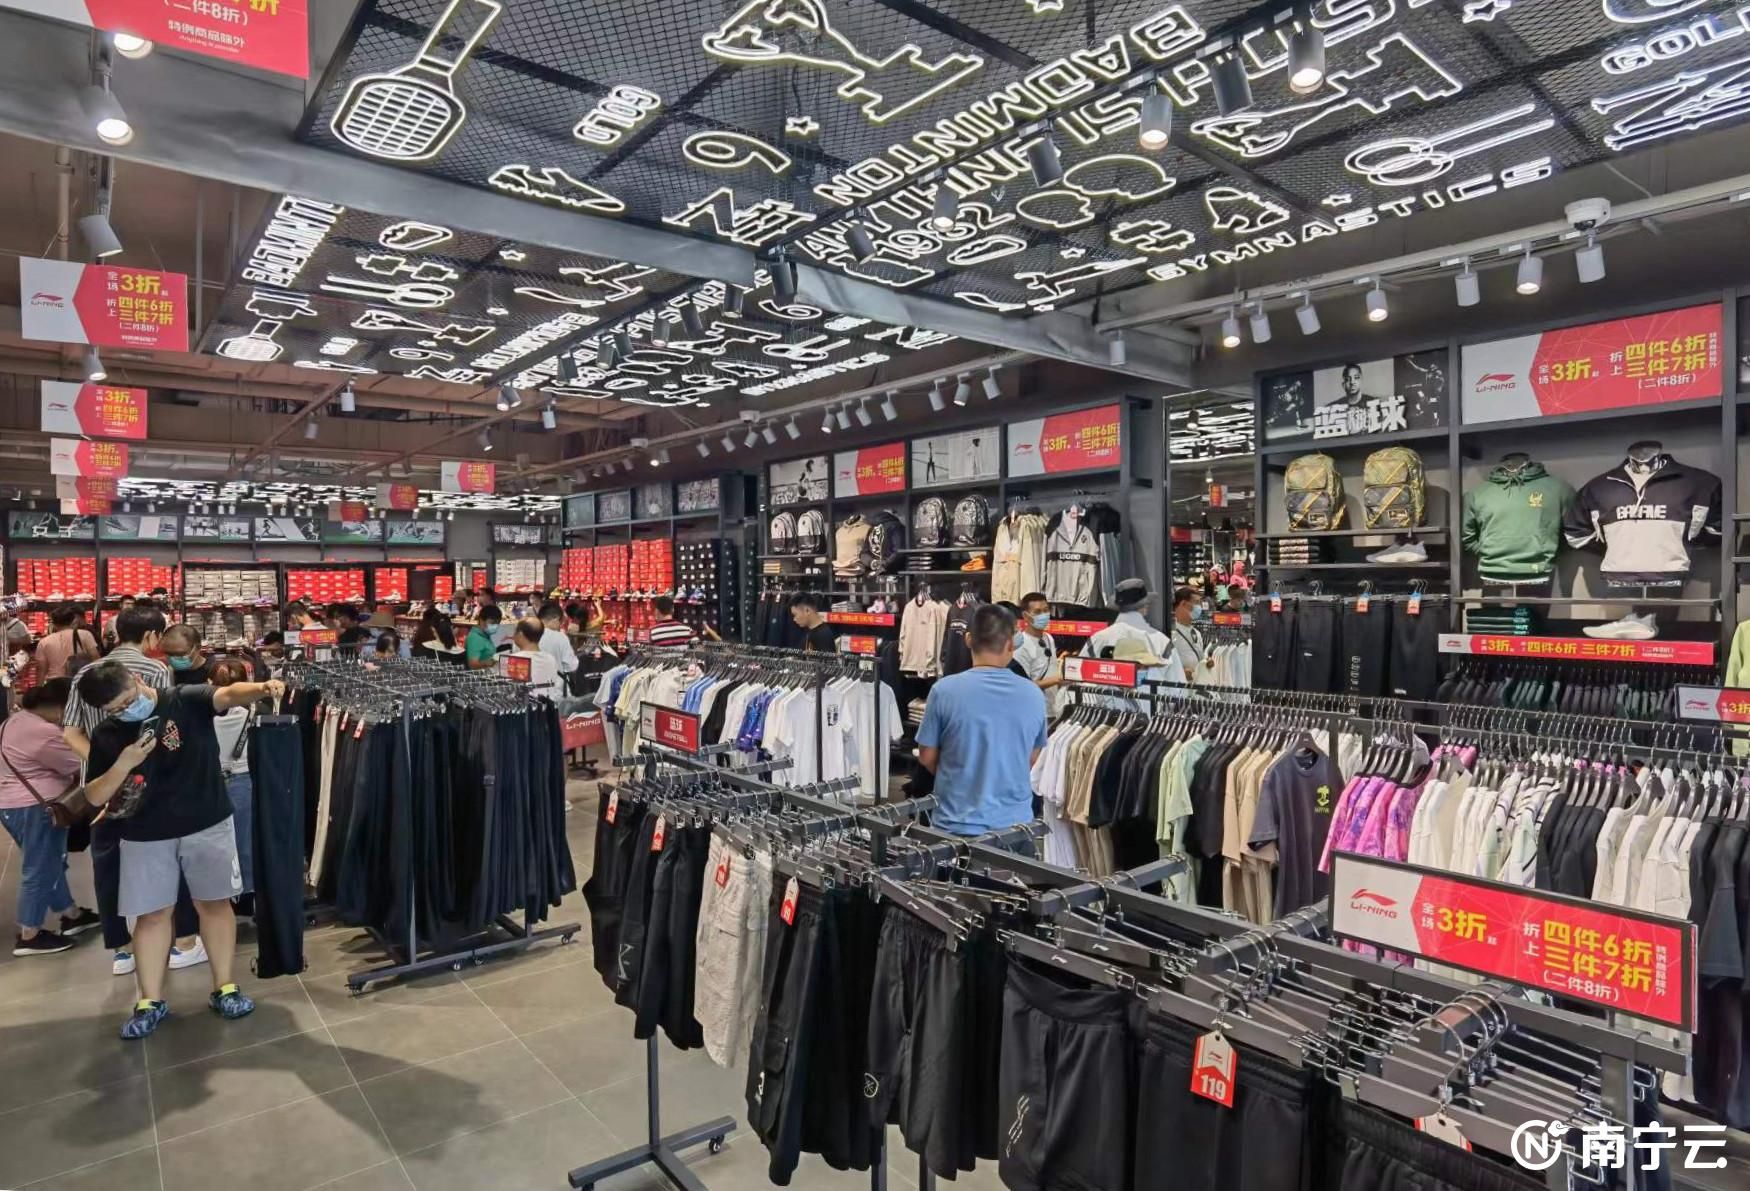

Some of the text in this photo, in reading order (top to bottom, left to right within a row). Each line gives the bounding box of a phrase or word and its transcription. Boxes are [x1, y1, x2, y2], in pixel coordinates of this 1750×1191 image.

[1601, 5, 1750, 74] GOL
[813, 4, 1206, 206] BADMINTON
[1056, 91, 1145, 145] IS
[1147, 156, 1552, 281] GYMNASTICS
[120, 273, 161, 295] 3折
[119, 296, 173, 313] 四件6折
[119, 309, 174, 325] 三件7折
[1609, 351, 1623, 377] 折上
[1625, 334, 1707, 360] 四件6折
[1625, 352, 1707, 378] 三件7折
[104, 389, 131, 403] 3折
[1476, 381, 1516, 393] LI-NING
[1049, 435, 1068, 451] 3折
[1488, 639, 1510, 652] 3折
[1527, 641, 1577, 655] 四件6折
[1582, 643, 1636, 657] 三件7折
[566, 718, 601, 730] LI-NING
[1351, 902, 1398, 919] LI-NING
[1421, 902, 1434, 930] 全场
[1522, 922, 1540, 957] 折上
[1543, 919, 1652, 964] 四件6折
[1543, 944, 1652, 993] 三件7折
[1543, 970, 1621, 1002] （二件8折）
[1201, 1073, 1226, 1100] 119
